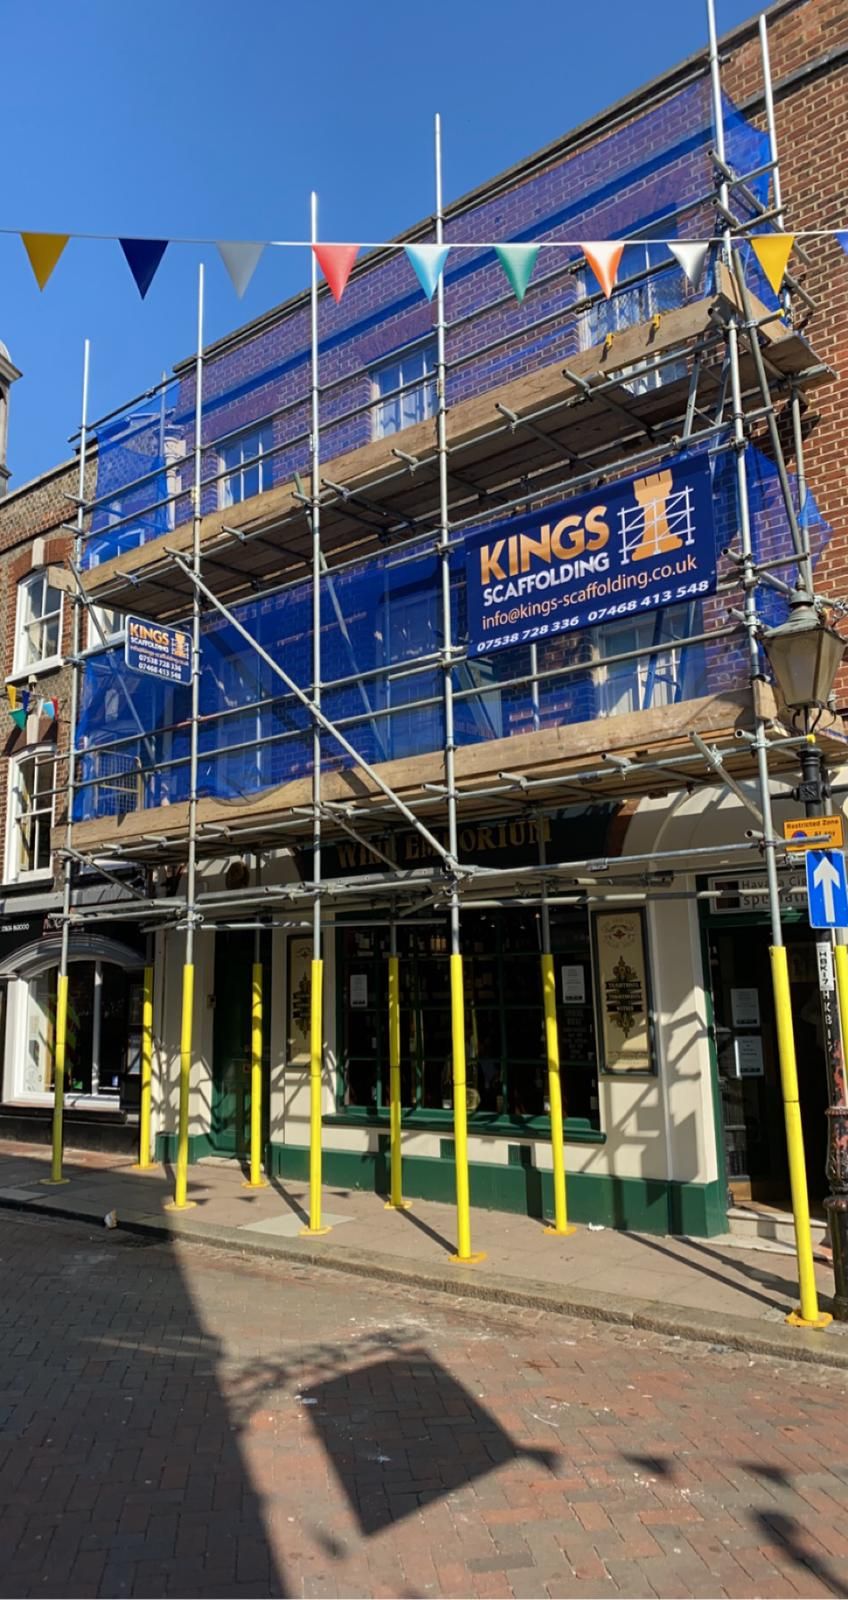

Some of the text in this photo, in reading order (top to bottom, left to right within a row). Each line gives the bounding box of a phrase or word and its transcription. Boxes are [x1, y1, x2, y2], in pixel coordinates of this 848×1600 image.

[480, 505, 610, 585] KINGS
[482, 554, 697, 631] info@kings-scaffolding.co.uk
[483, 552, 610, 607] SCAFFOLDING
[130, 623, 169, 645] KINGS
[477, 580, 709, 652] 07538 728 336 07468 413 548
[786, 820, 821, 829] Restricted
